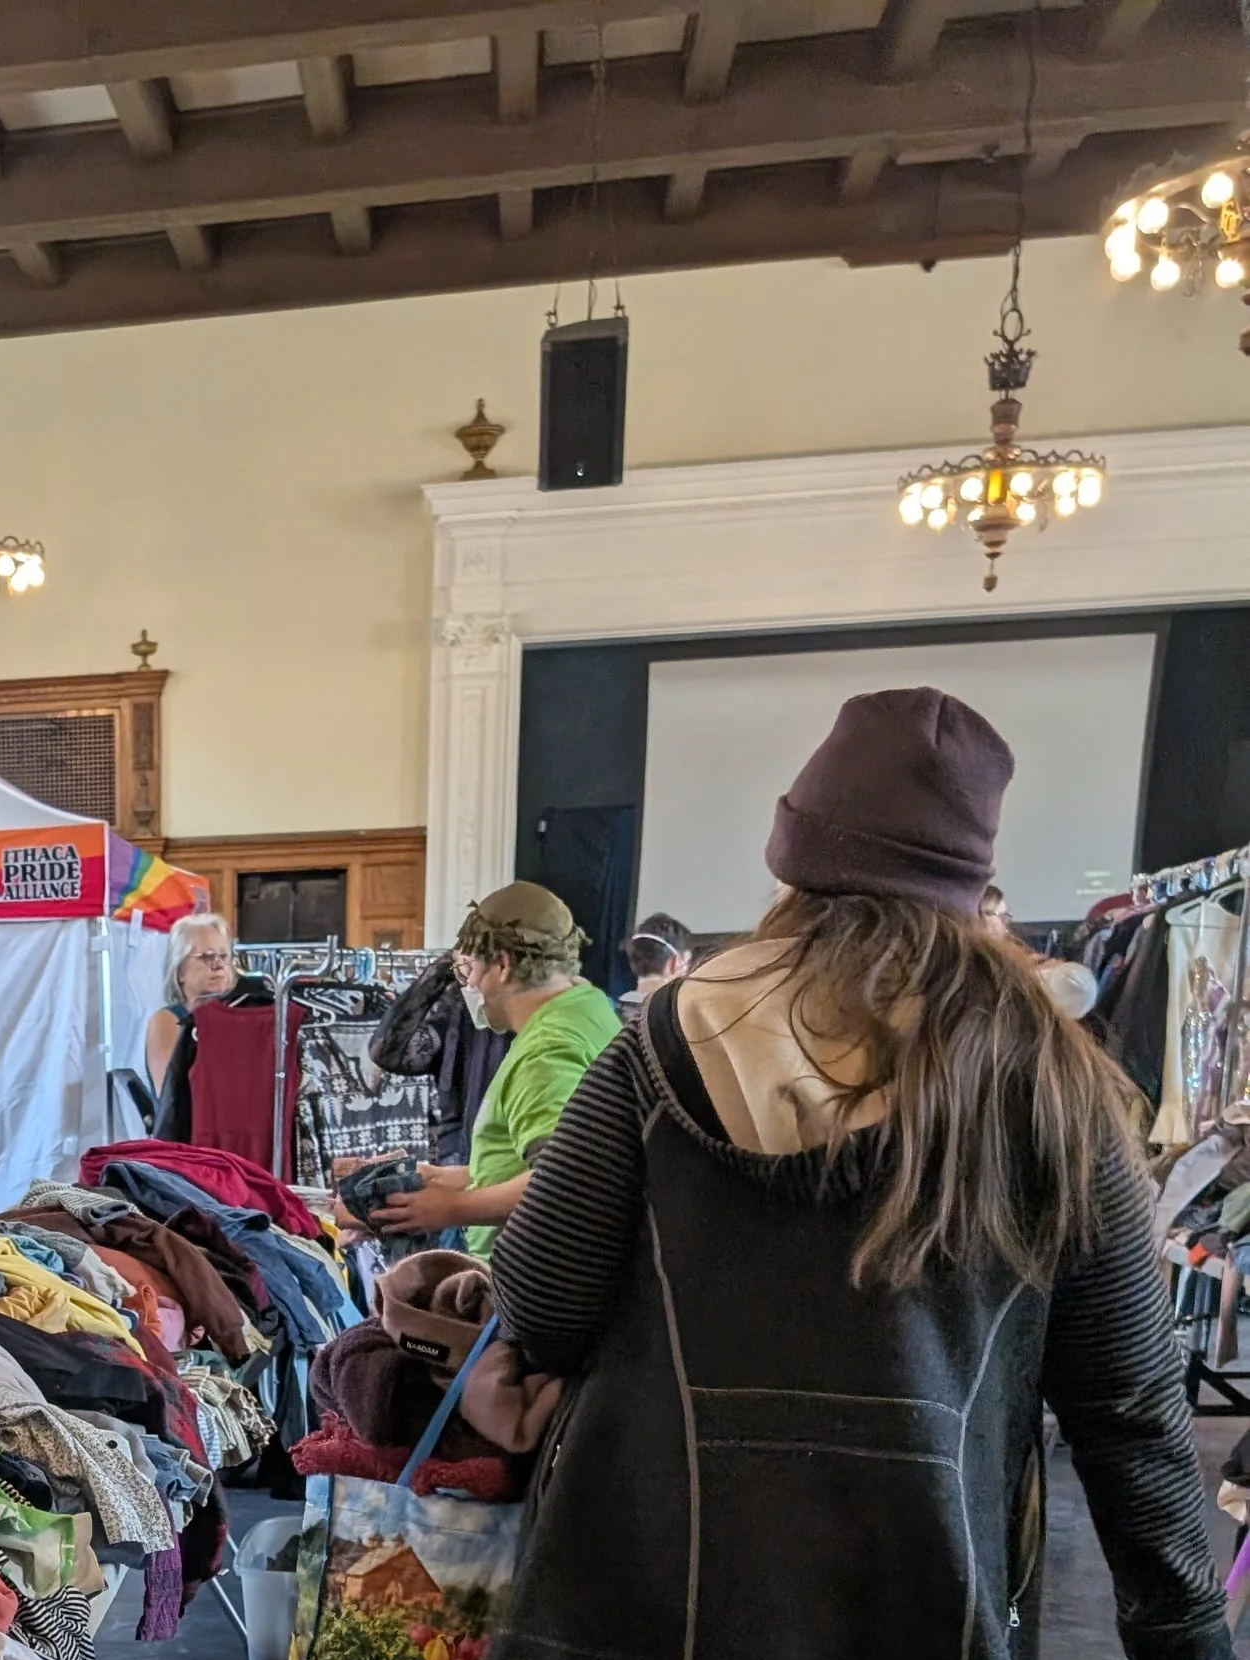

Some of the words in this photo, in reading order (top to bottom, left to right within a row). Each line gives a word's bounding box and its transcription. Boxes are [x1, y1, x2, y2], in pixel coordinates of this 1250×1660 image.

[3, 845, 78, 863] ITHACA
[4, 861, 80, 883] PRIDE
[3, 881, 79, 900] ALLIANCE
